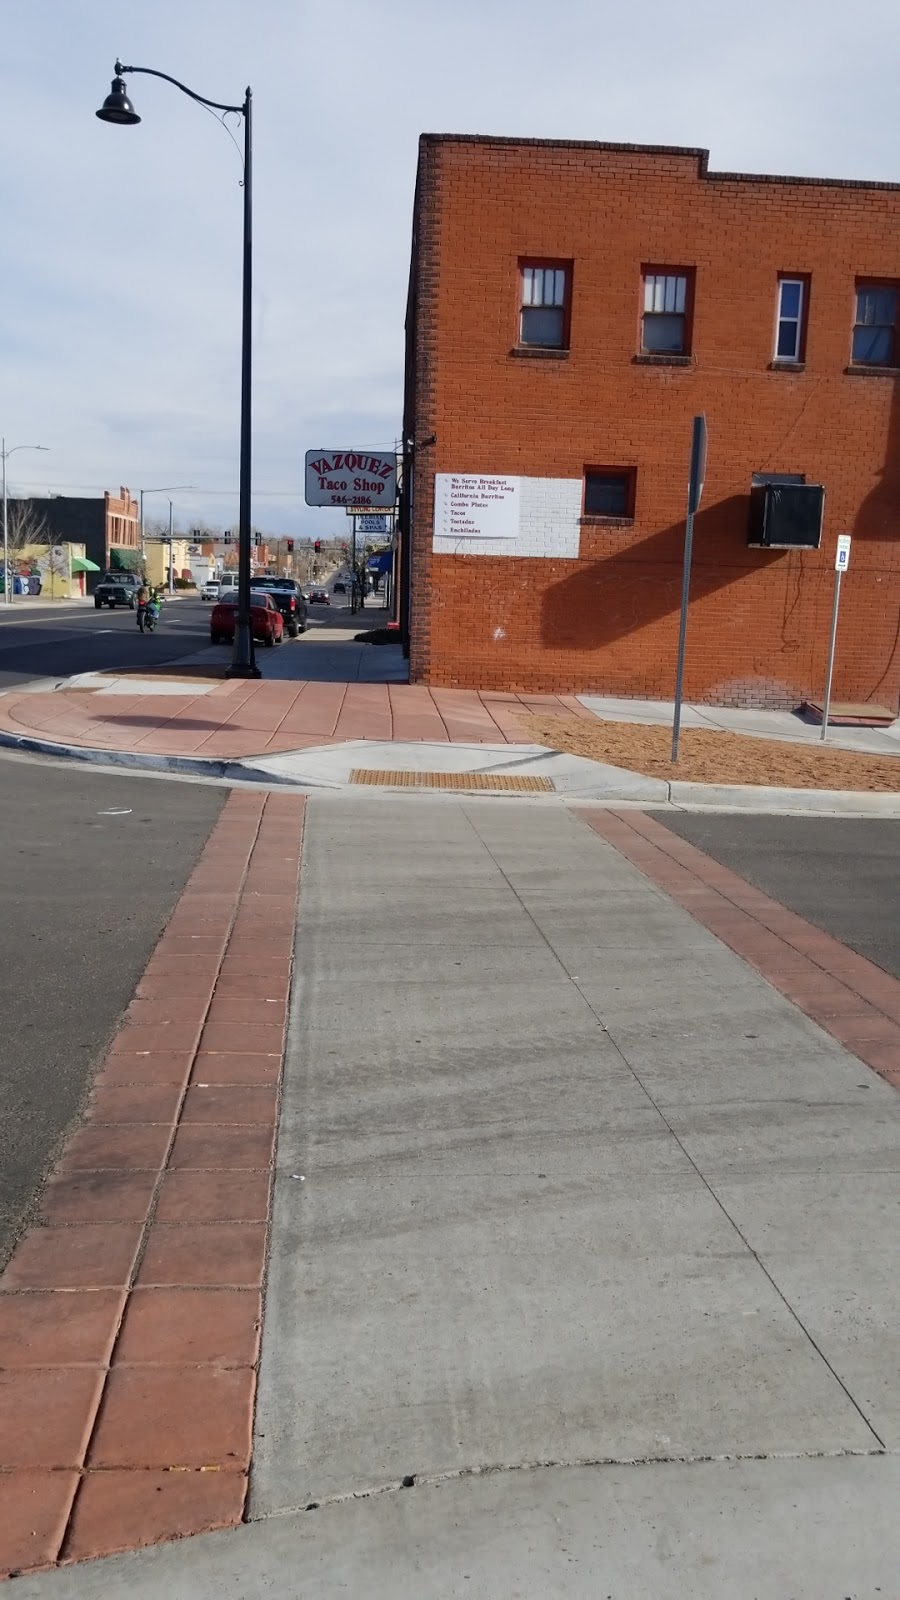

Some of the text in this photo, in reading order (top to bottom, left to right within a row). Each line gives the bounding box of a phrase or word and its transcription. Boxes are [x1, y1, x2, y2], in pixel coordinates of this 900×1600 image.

[308, 453, 394, 480] VAZQUEZ
[317, 476, 385, 495] Taco Shop
[331, 495, 372, 504] 546-2186
